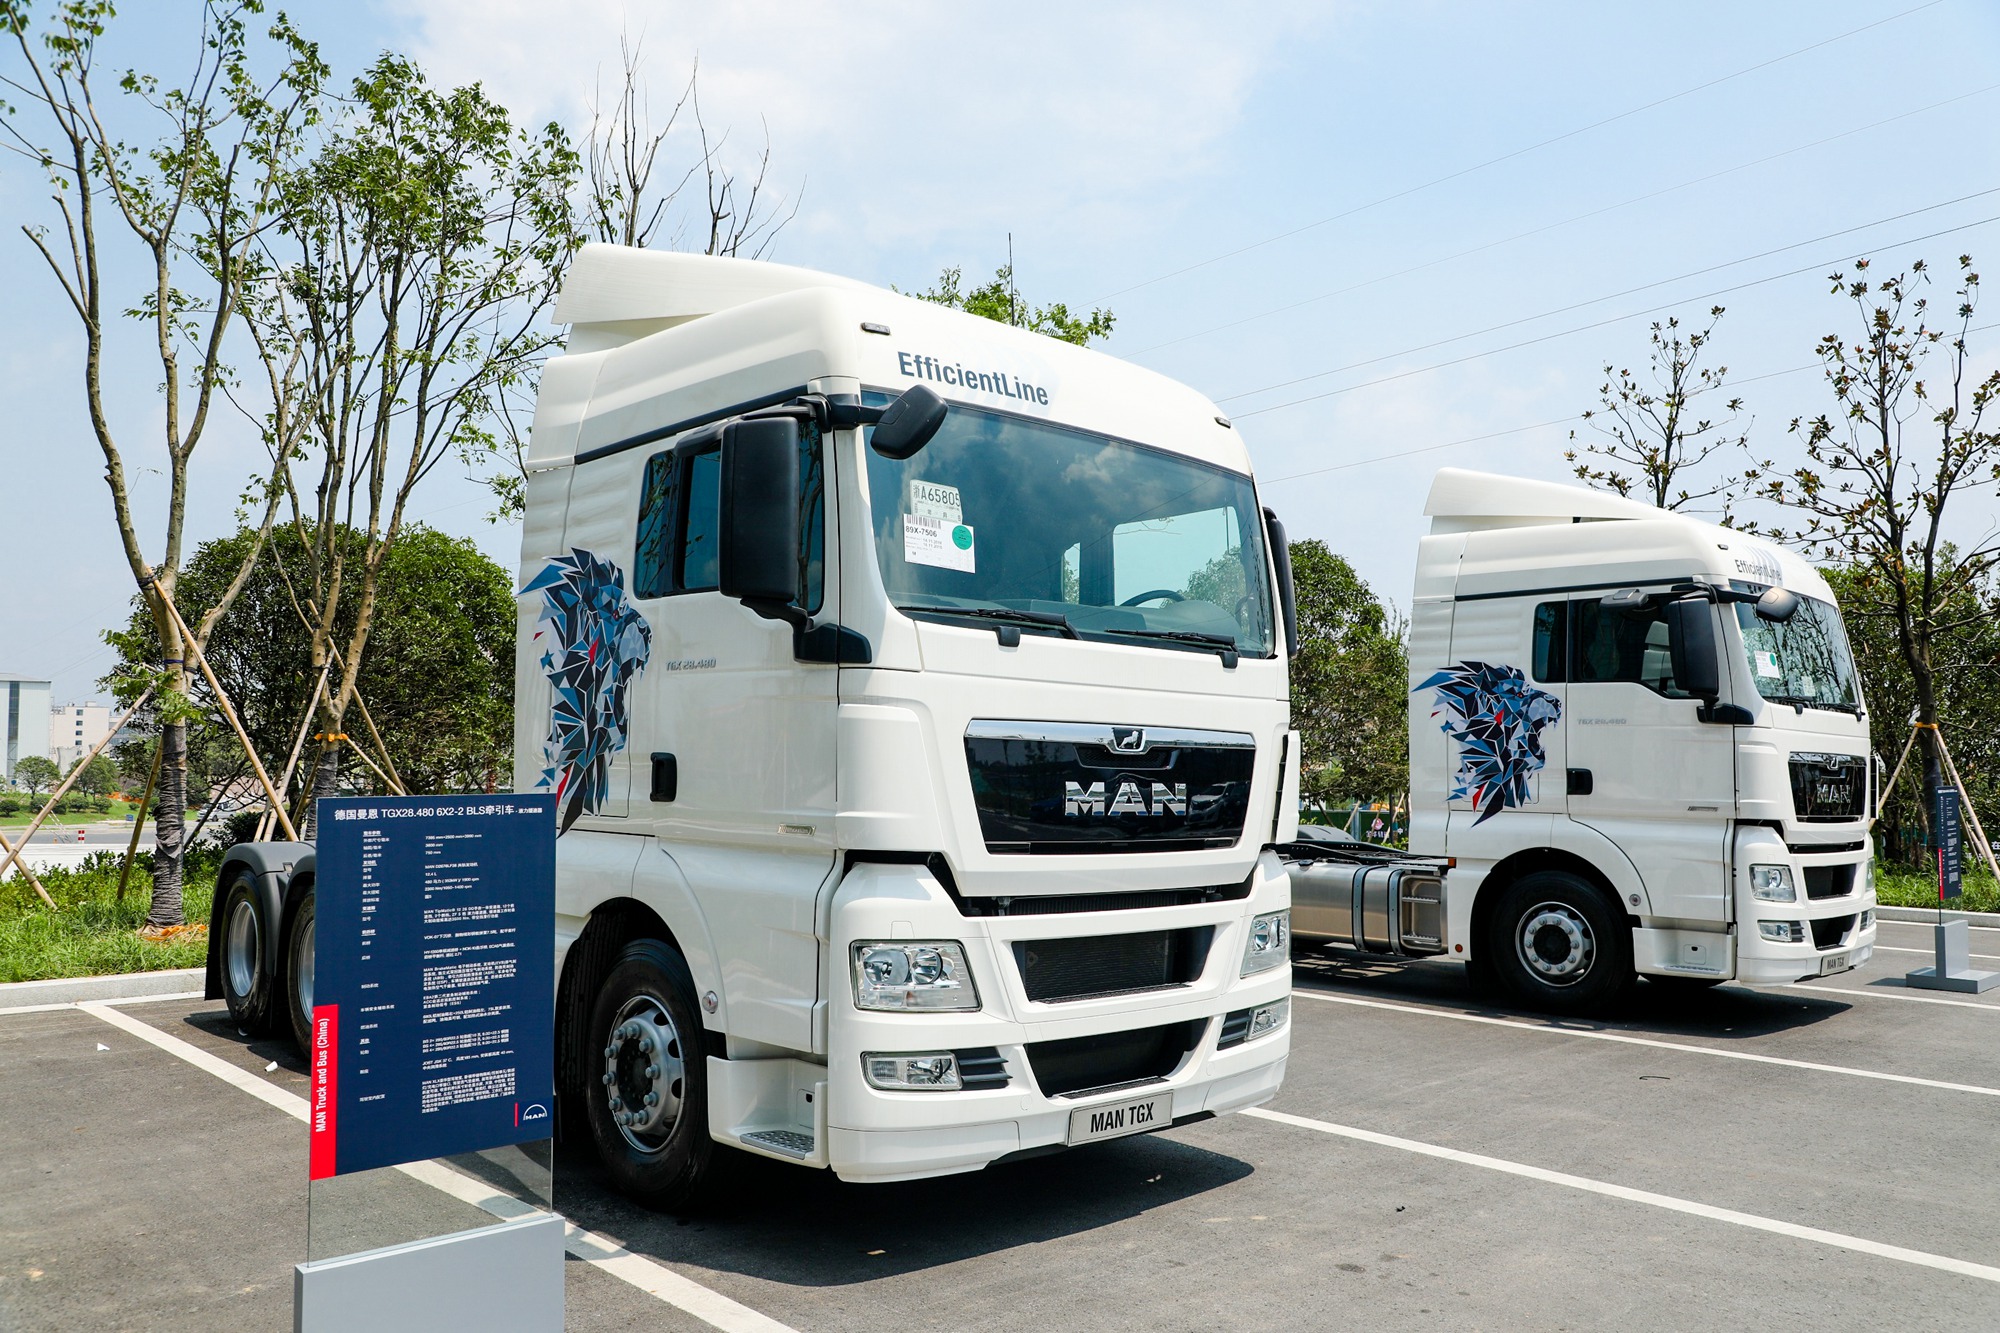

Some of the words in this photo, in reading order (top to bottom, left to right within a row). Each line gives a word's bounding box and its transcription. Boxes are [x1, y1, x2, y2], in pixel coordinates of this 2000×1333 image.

[898, 351, 1049, 406] EfficientLine
[1065, 781, 1187, 816] MAN
[1816, 784, 1851, 803] MAN
[334, 808, 379, 821] 德国曼恩
[380, 807, 435, 819] TGX28.480
[436, 806, 464, 817] 6X2-2
[317, 1018, 330, 1049] (China)
[317, 1050, 327, 1067] Bus
[317, 1067, 327, 1084] and
[316, 1085, 327, 1110] Truck
[315, 1111, 326, 1132] MAN
[1090, 1108, 1124, 1133] MAN
[1129, 1102, 1154, 1125] TGX
